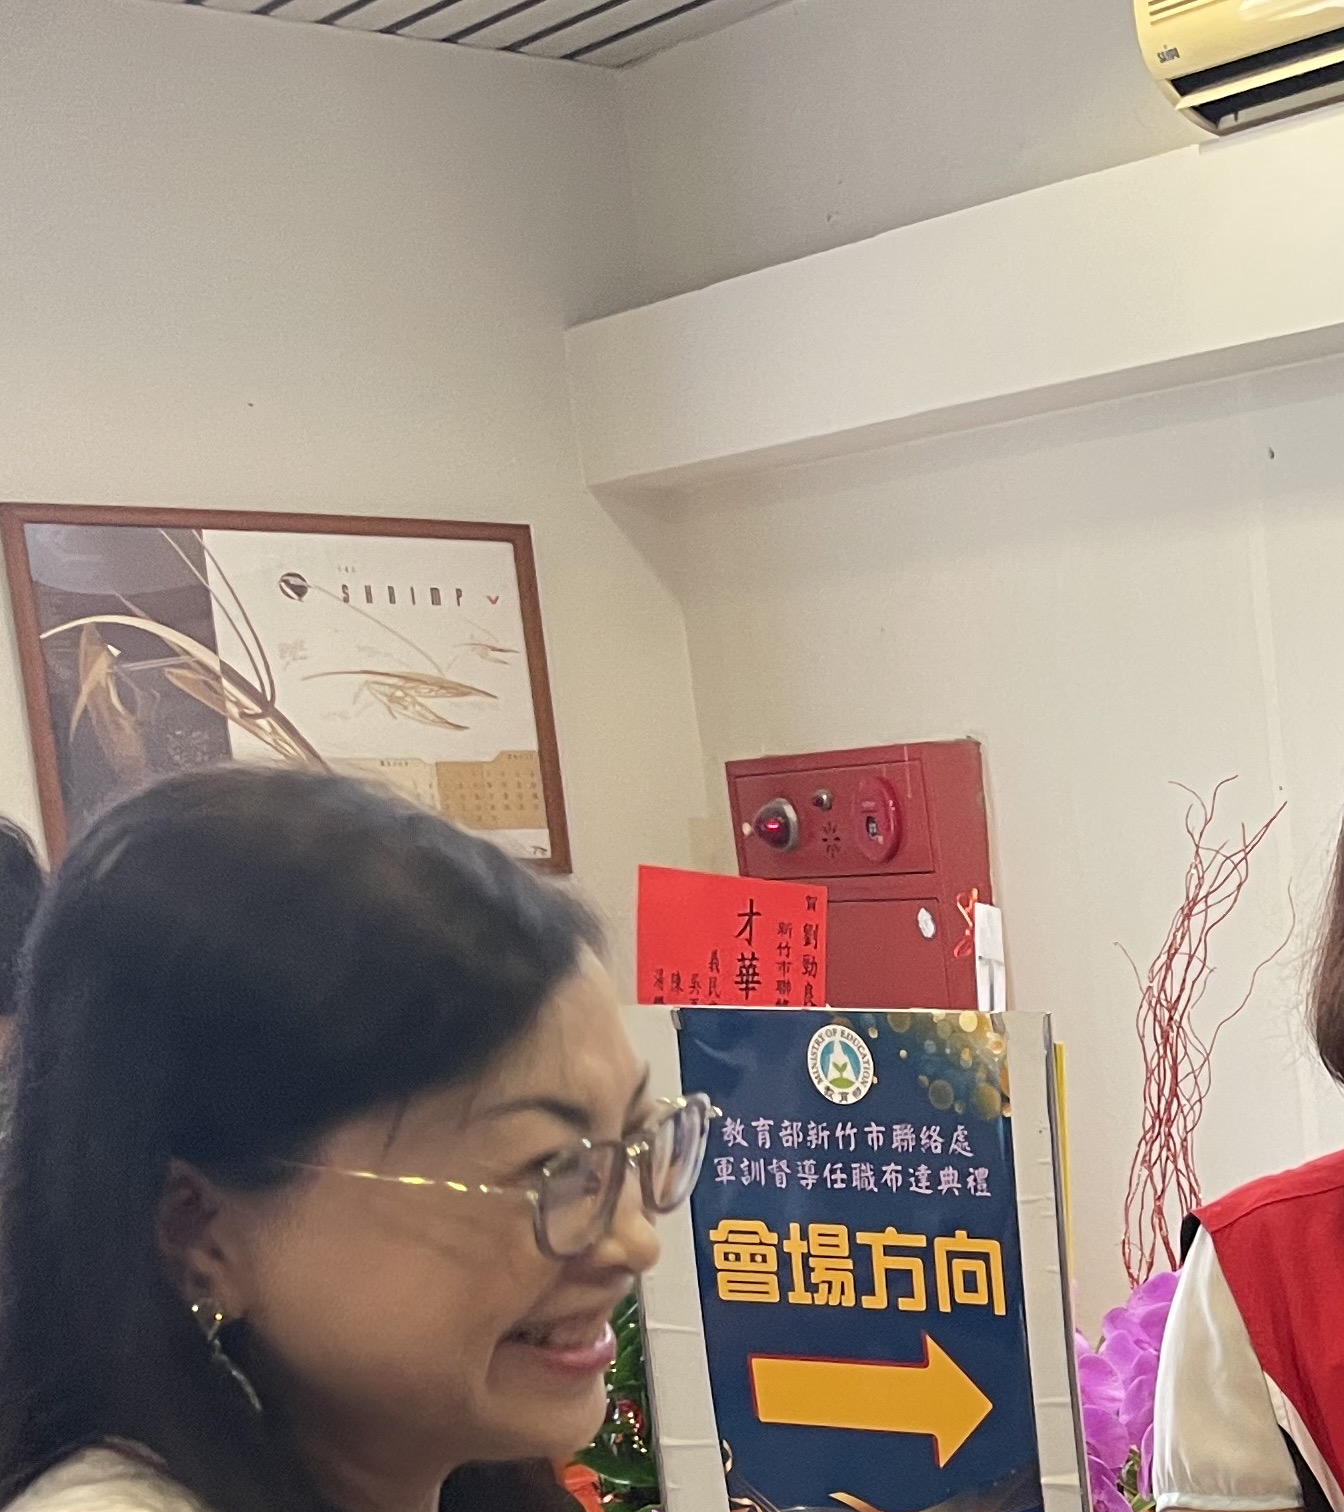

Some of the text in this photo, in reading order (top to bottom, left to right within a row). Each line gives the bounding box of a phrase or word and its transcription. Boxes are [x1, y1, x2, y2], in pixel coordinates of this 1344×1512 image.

[721, 1117, 975, 1158] 教育部新竹市聯絡處
[713, 1156, 992, 1198] 軍訓督導任職布達典禮
[709, 1218, 1007, 1317] 會場方向
